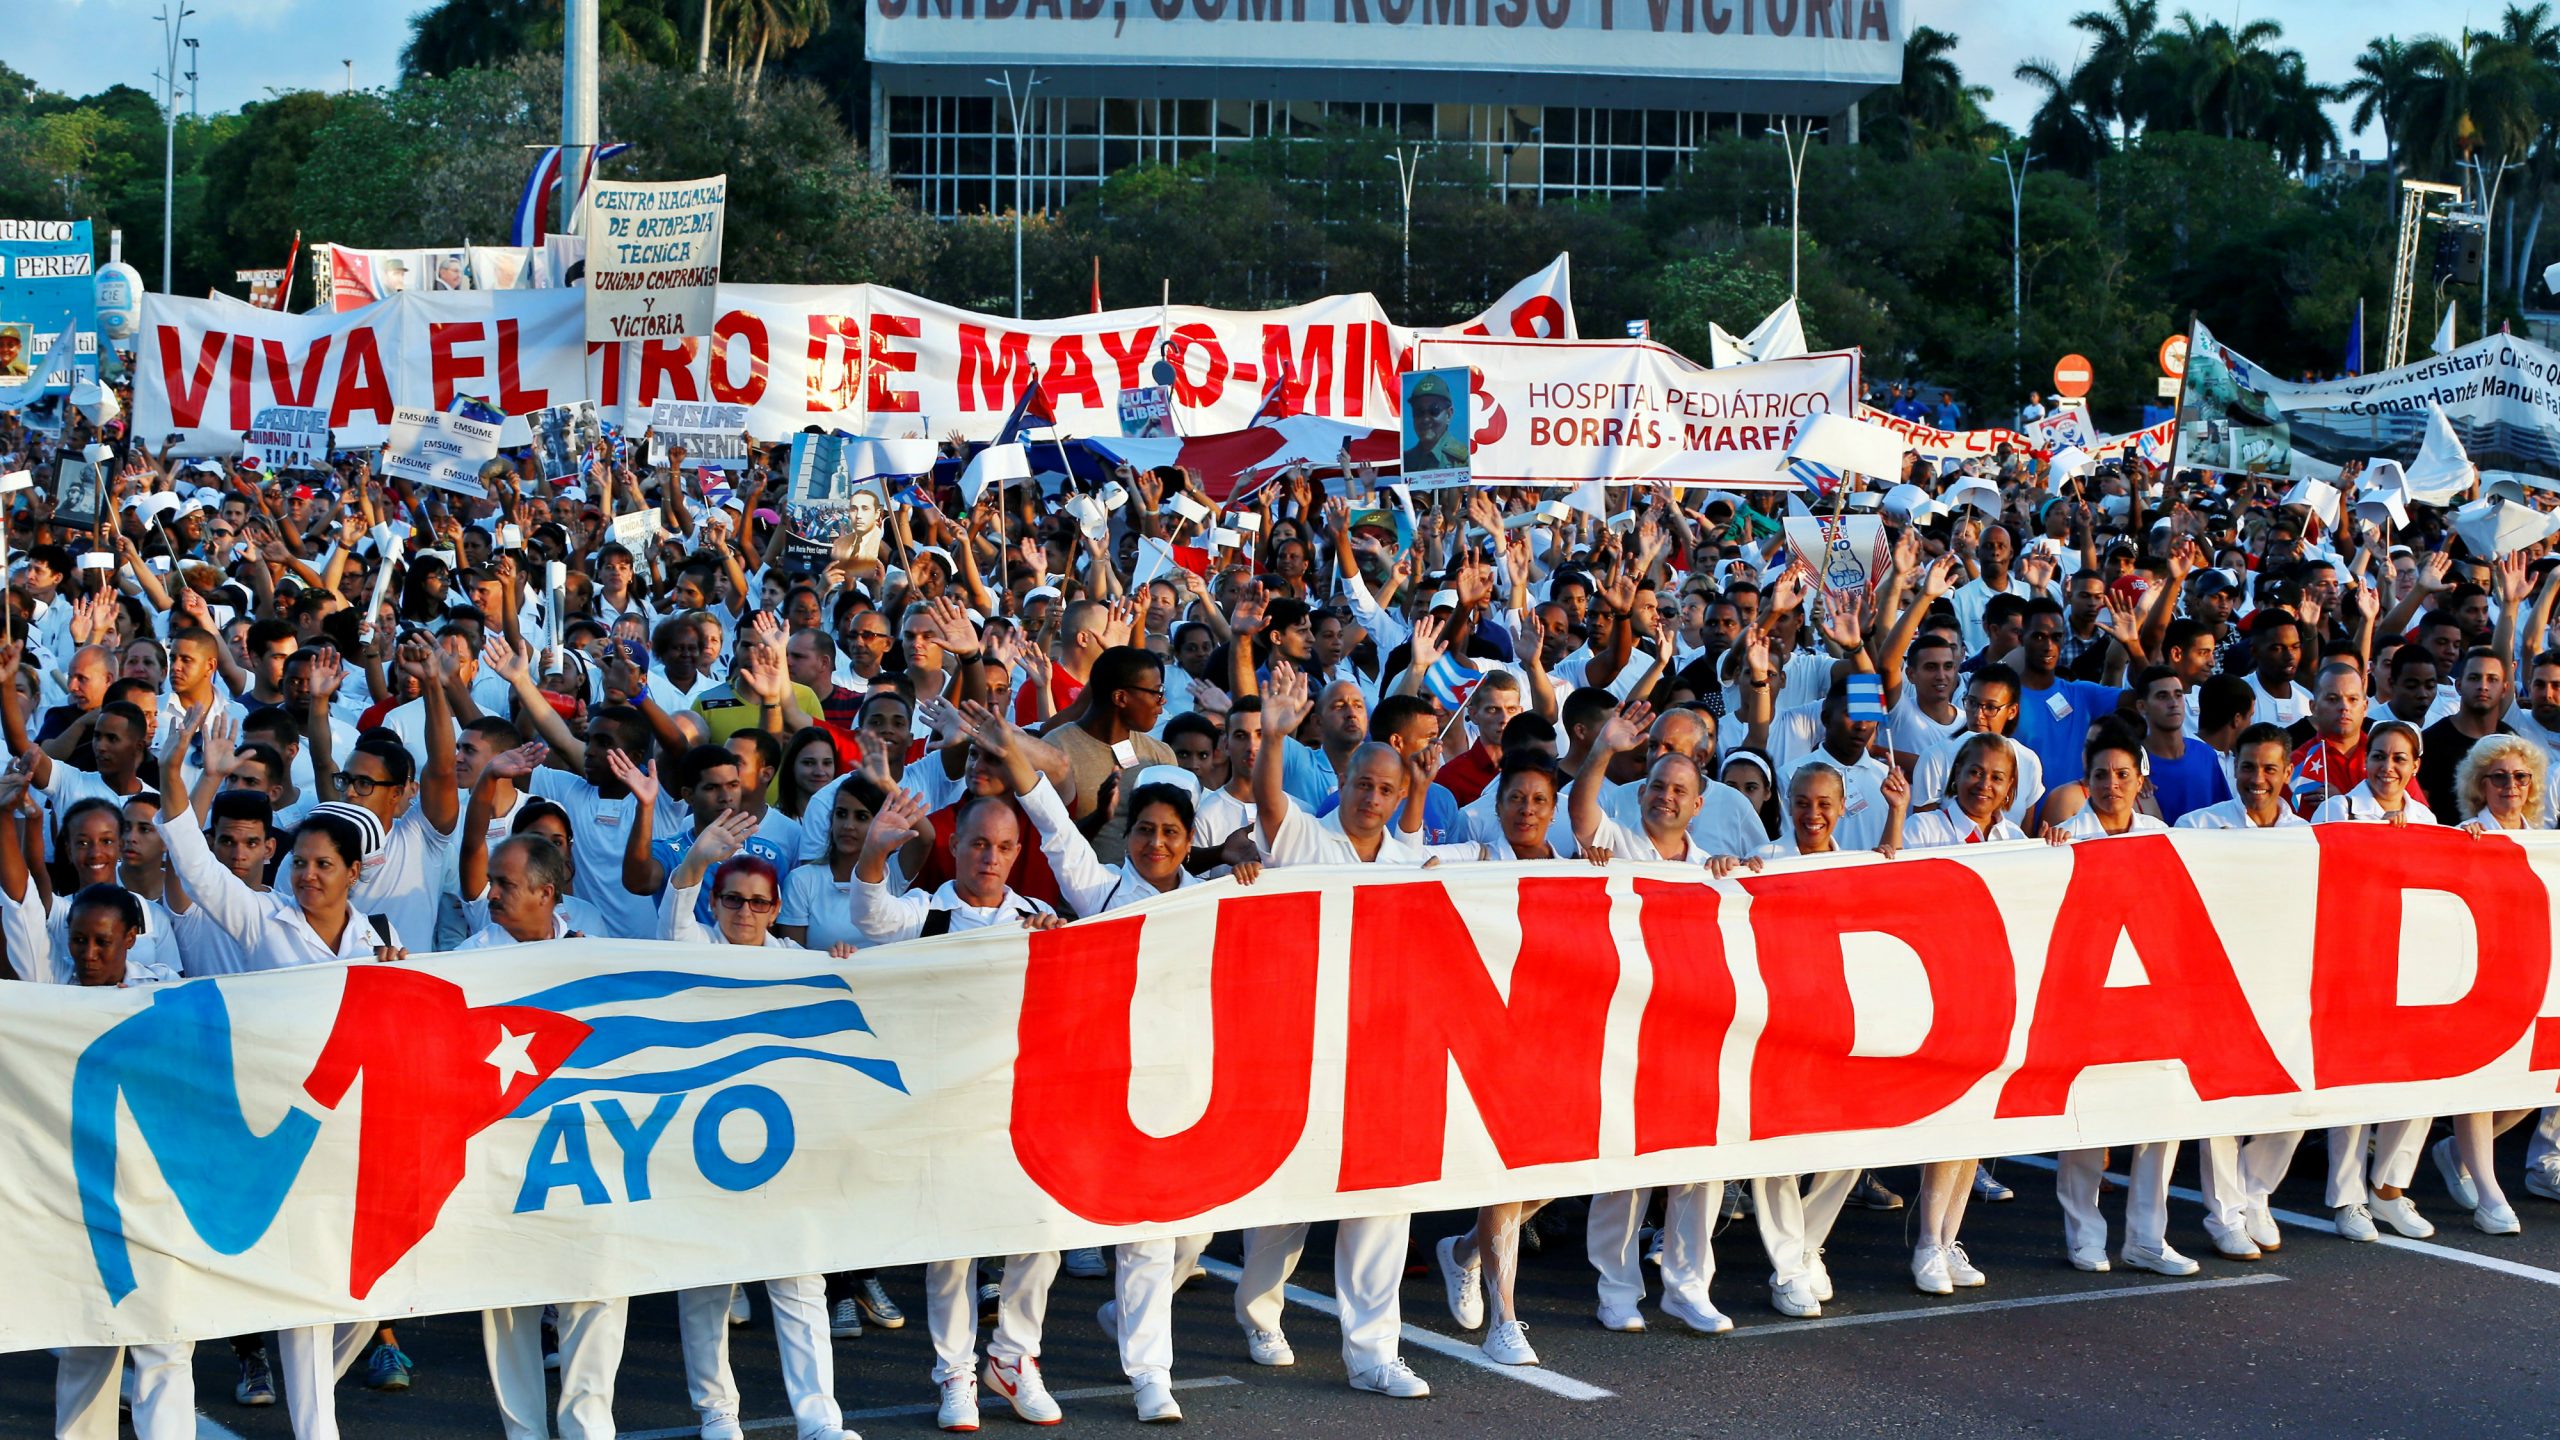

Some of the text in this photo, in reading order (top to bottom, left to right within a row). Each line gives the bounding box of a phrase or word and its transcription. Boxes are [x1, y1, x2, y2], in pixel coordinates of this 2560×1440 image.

[594, 185, 724, 211] CENTRO NACIONAL
[608, 212, 714, 238] DE ORTOPEDIA
[17, 254, 91, 278] PEREZ
[643, 298, 655, 313] Y
[157, 325, 394, 430] VIVA
[429, 318, 549, 416] EL
[587, 310, 769, 408] 1RO
[806, 313, 921, 412] DE
[1122, 389, 1162, 408] LULA
[1529, 382, 1831, 418] HOSPITAL PEDIÁTRICO
[2482, 375, 2544, 407] Manuel
[252, 408, 328, 434] EMSUME
[399, 411, 440, 425] EMSUME
[1123, 403, 1168, 421] LIBRE
[298, 433, 312, 449] LA
[453, 421, 493, 439] EMSUME
[1531, 412, 1662, 449] BORRÁS
[1684, 420, 1798, 451] MARFÁ
[424, 440, 463, 454] EMSUME
[651, 430, 748, 460] PRESENTE
[391, 455, 432, 471] EMSUME
